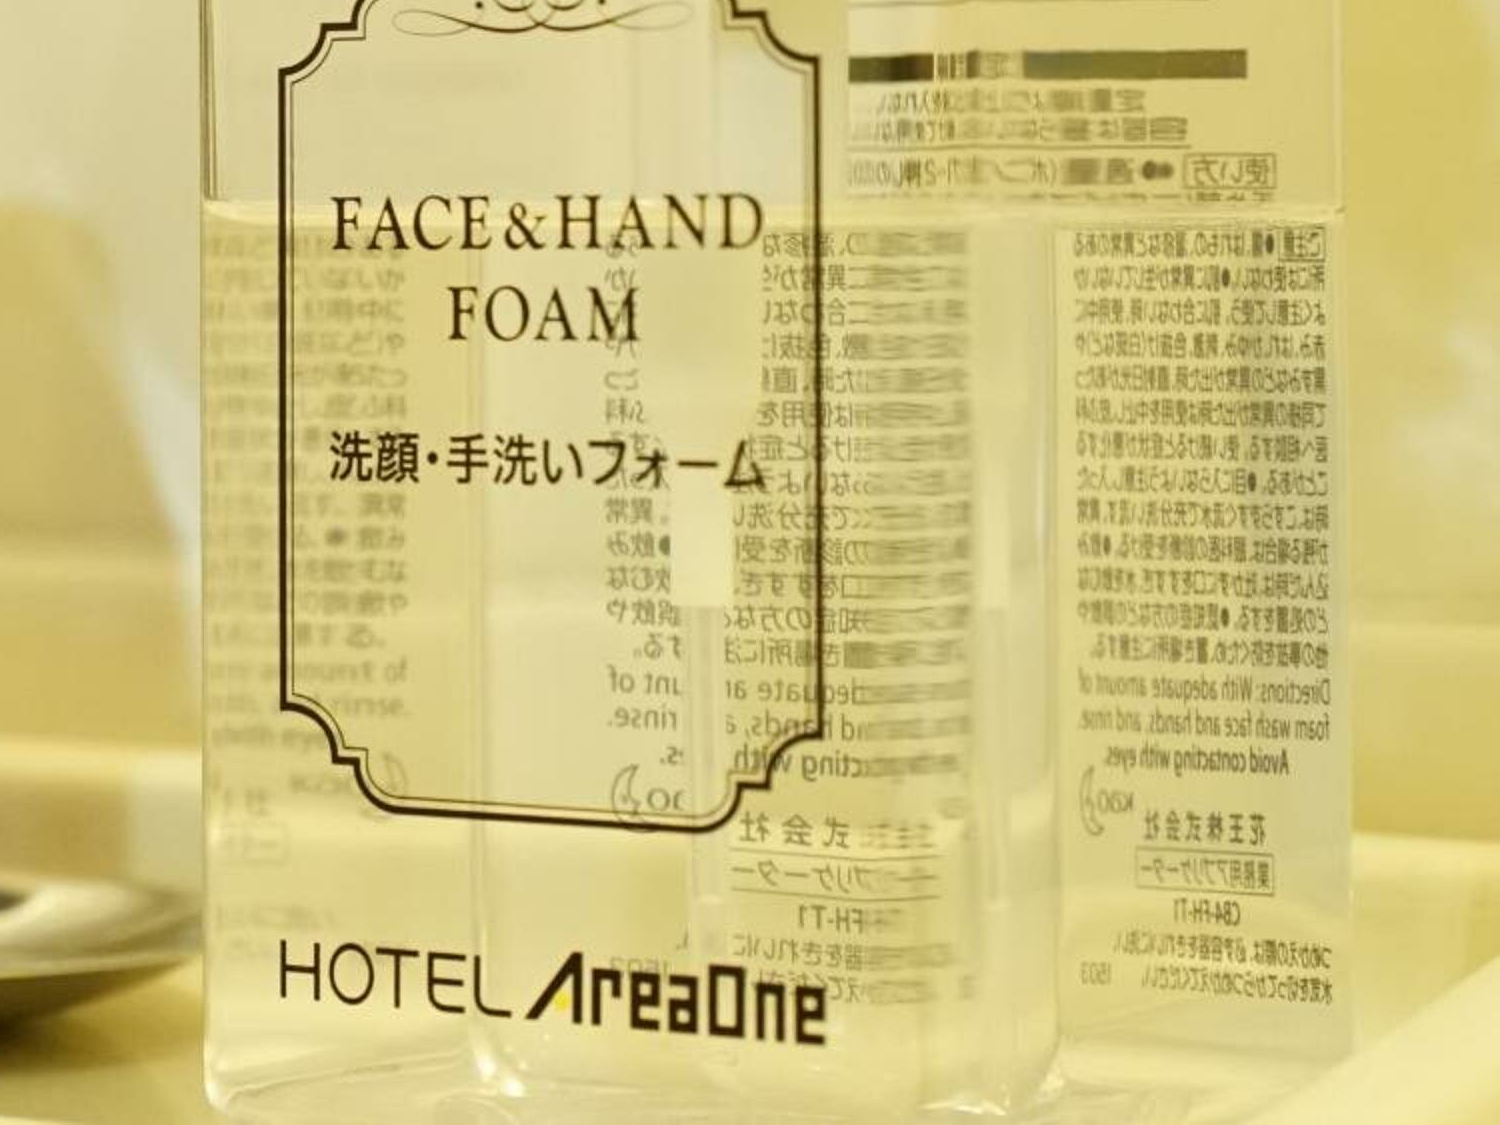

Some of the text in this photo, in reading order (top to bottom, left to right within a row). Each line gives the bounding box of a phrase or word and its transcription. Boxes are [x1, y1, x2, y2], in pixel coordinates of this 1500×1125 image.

[448, 286, 641, 341] FOAM
[280, 939, 826, 1045] HOTEL AreaOne
